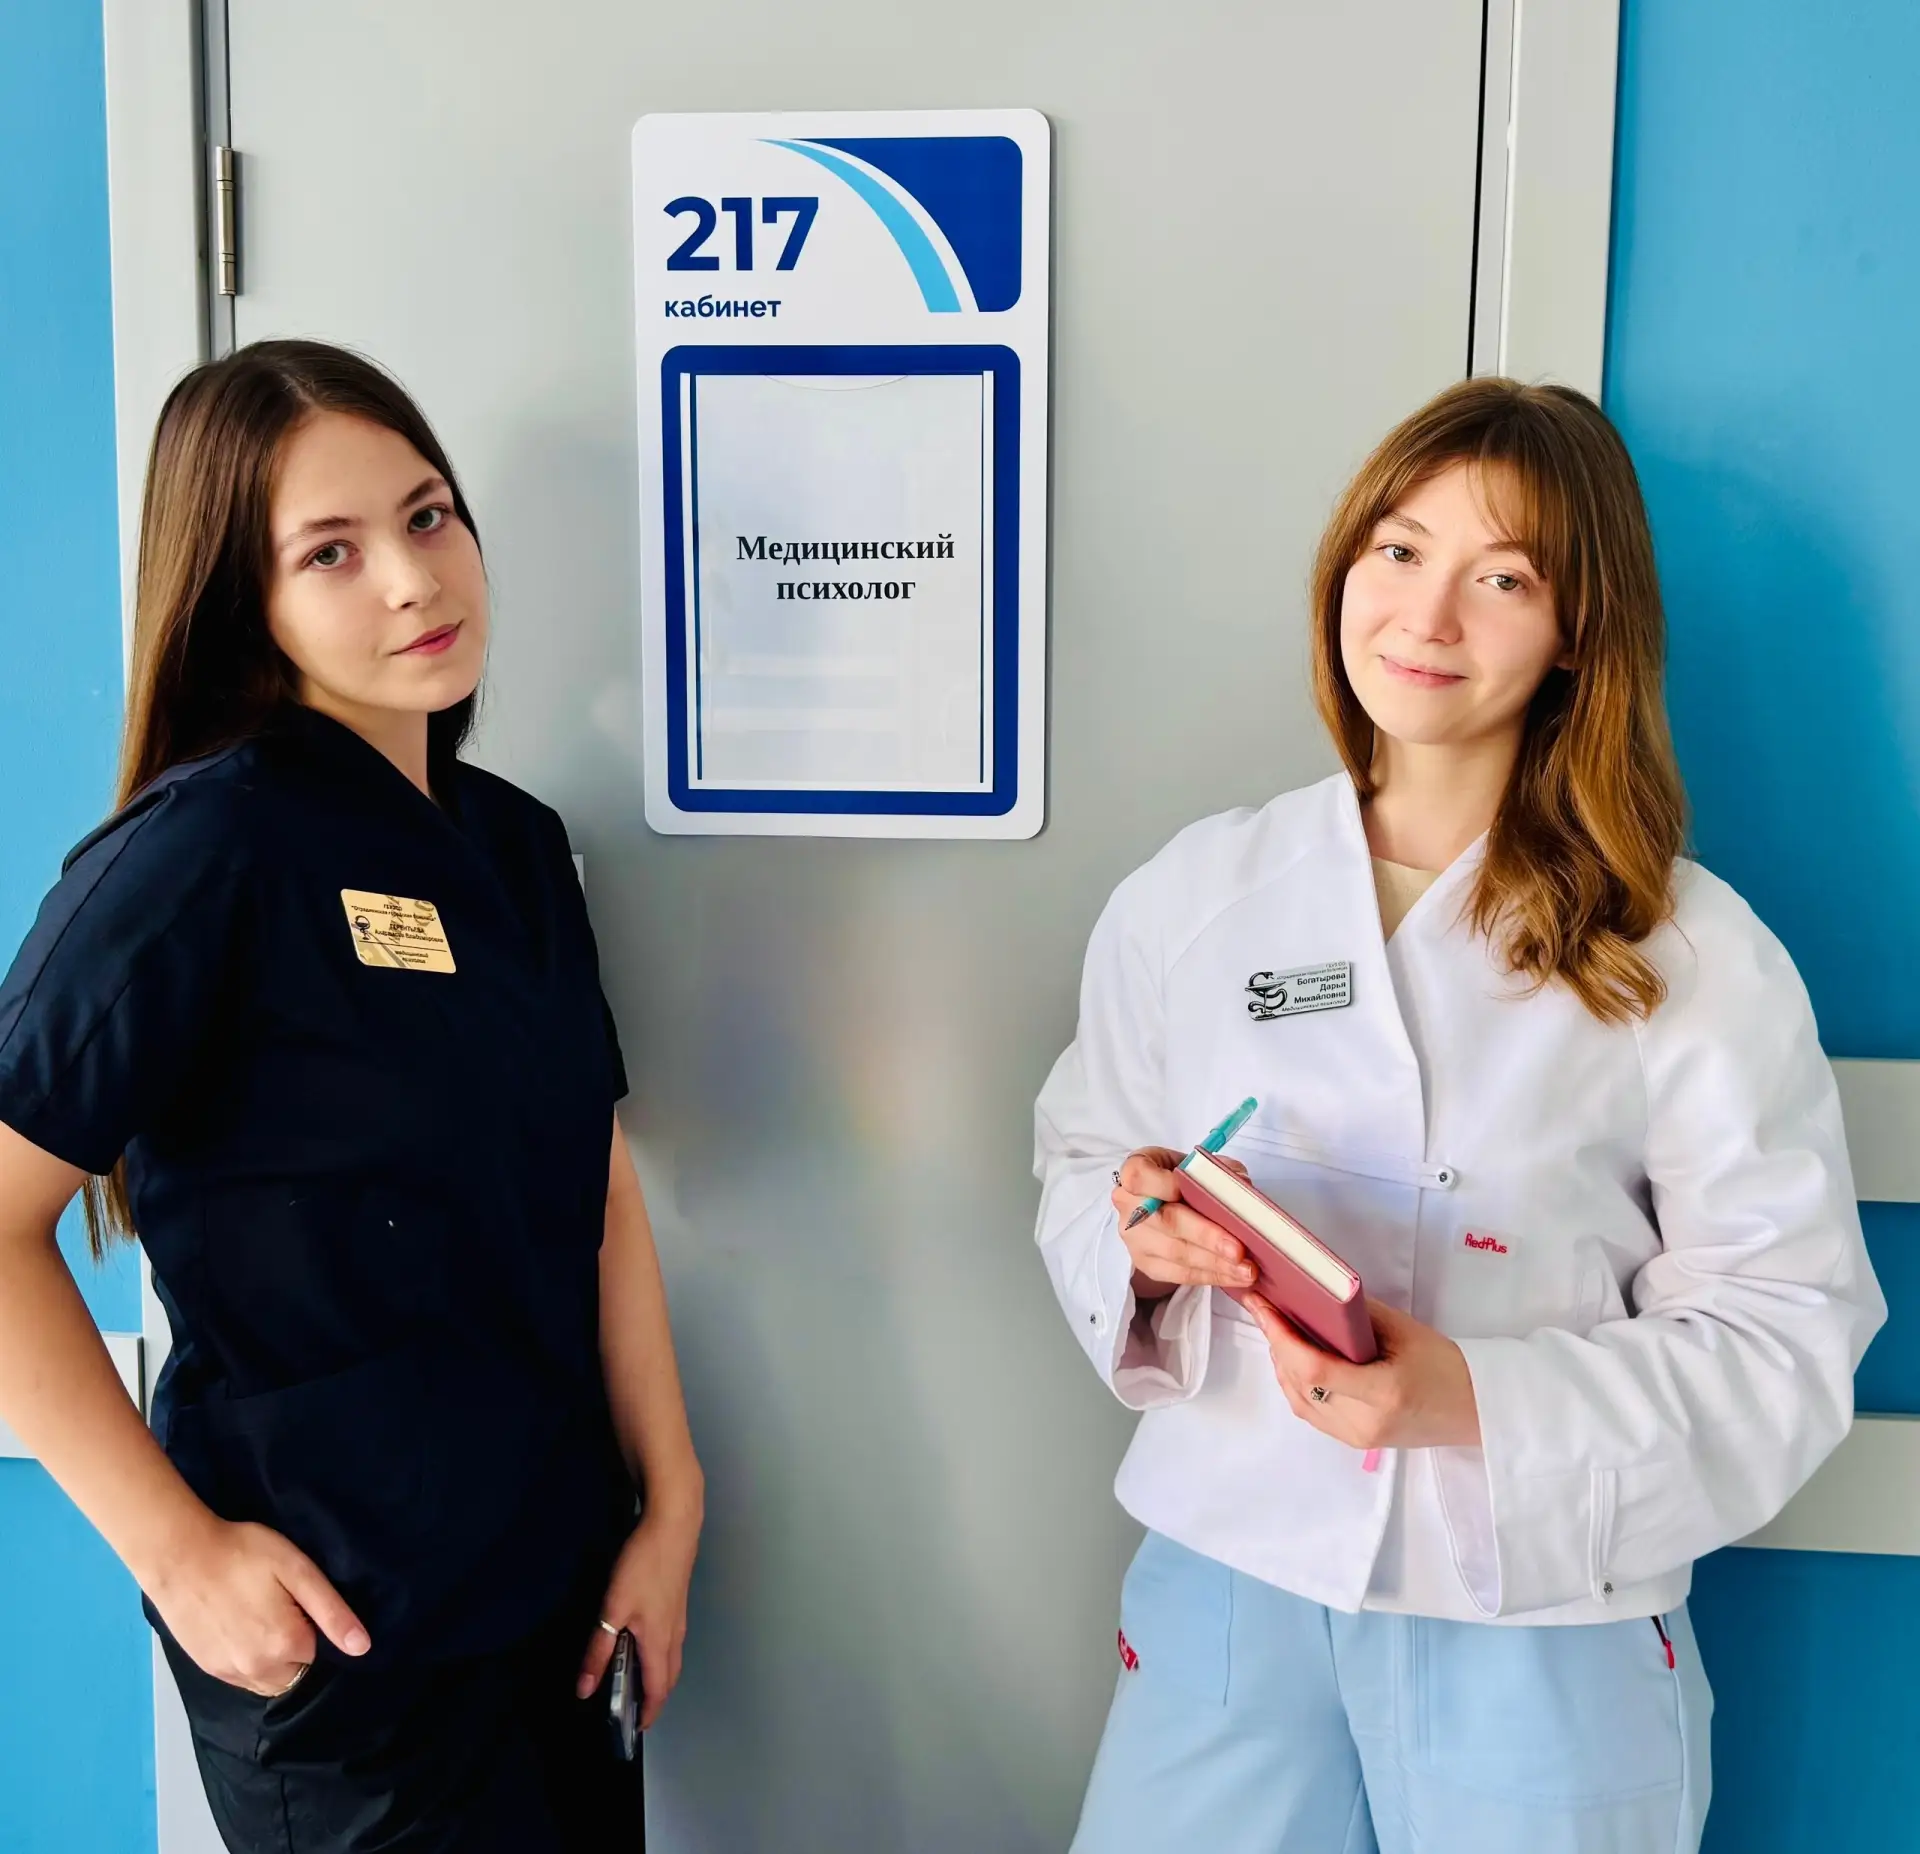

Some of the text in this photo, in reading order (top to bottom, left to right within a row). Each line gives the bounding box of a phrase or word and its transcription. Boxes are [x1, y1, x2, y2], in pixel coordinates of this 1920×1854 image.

[663, 196, 819, 271] 217
[664, 294, 782, 318] кабинет
[736, 533, 955, 566] Медицинский
[776, 581, 916, 600] психолог
[1297, 973, 1346, 986] Богатырева
[1320, 982, 1346, 992] Дарья
[1294, 991, 1346, 1004] Михайловна
